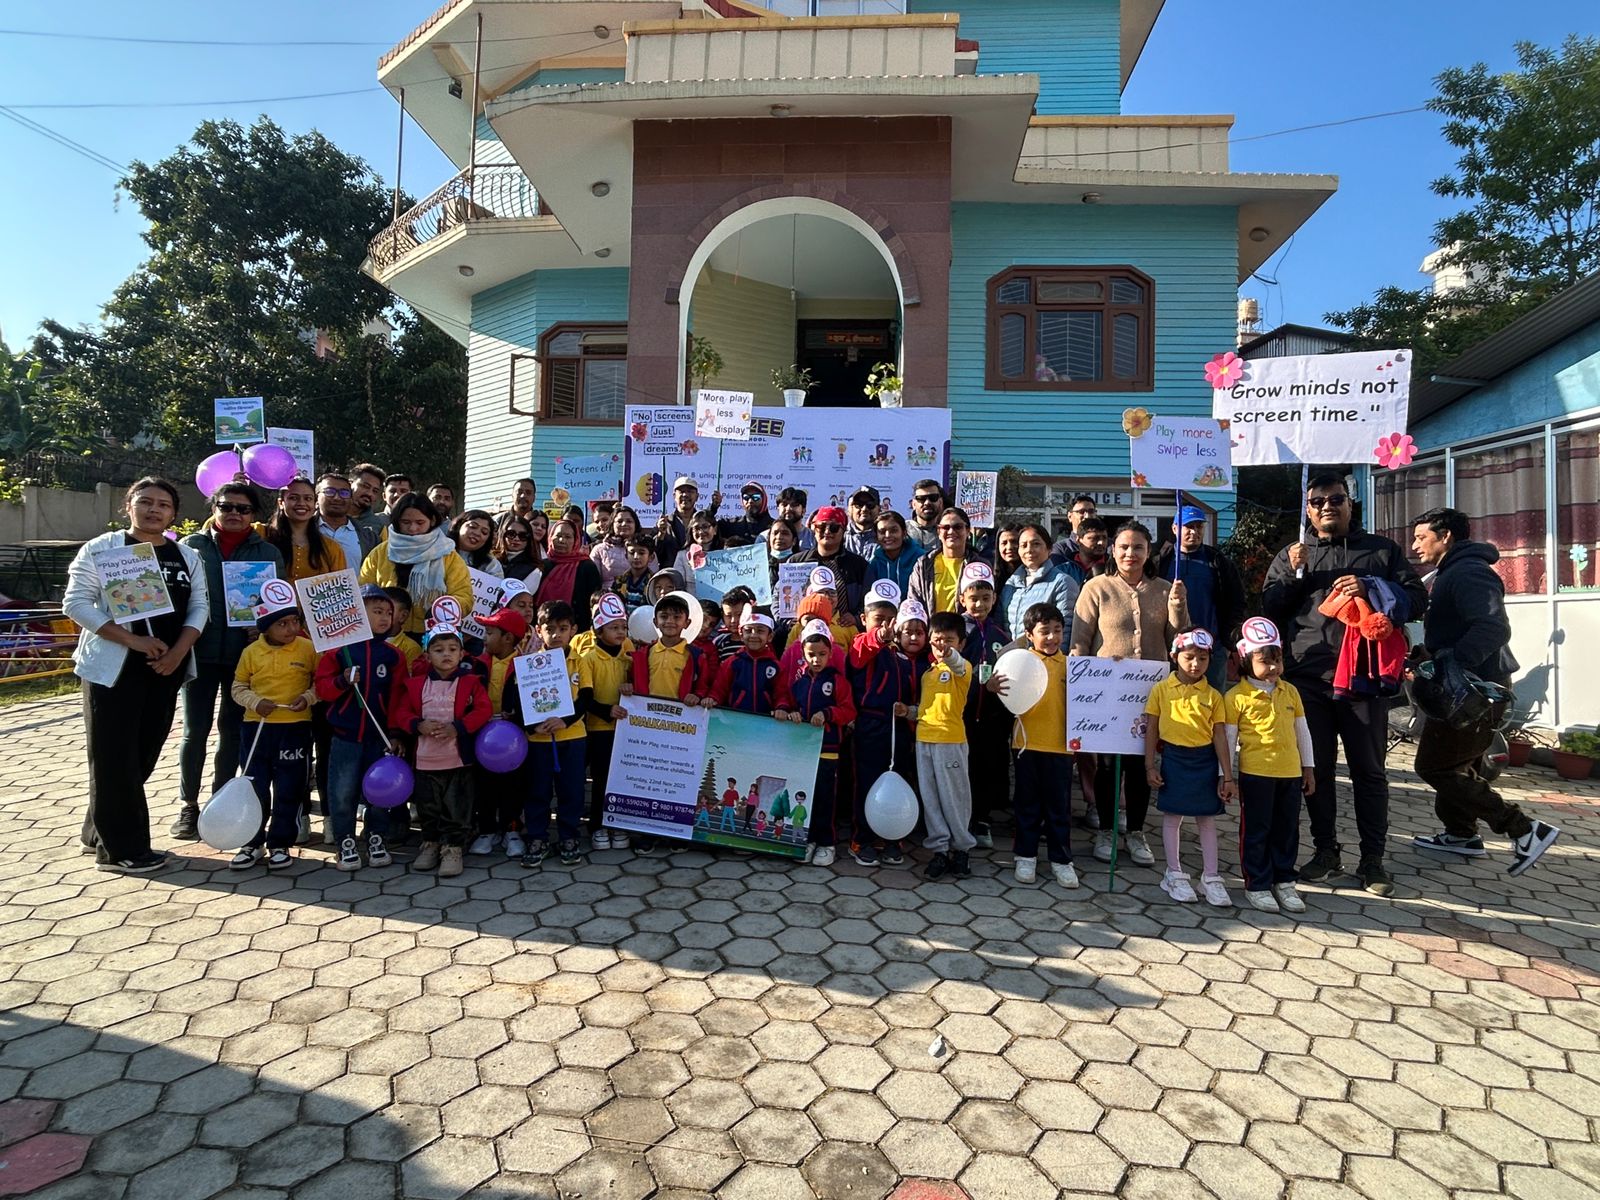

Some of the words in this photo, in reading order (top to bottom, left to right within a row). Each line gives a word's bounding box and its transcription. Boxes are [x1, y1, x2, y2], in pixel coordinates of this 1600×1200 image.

[1289, 378, 1350, 396] minds
[1361, 377, 1399, 395] not
[716, 408, 733, 418] less
[1232, 408, 1301, 424] screen
[653, 427, 672, 436] Just
[1156, 425, 1175, 442] Play
[1196, 443, 1217, 457] less
[563, 463, 599, 475] Screens
[727, 473, 773, 482] programmes
[737, 550, 753, 562] and
[105, 570, 121, 579] Not
[711, 570, 727, 585] play
[306, 577, 350, 597] UNPLUG
[323, 588, 337, 597] THE
[311, 589, 353, 611] SCREENS
[314, 599, 356, 623] UNLEASH
[317, 613, 361, 638] POTENTIAL
[1119, 668, 1164, 683] minds
[1072, 691, 1103, 703] not
[1118, 694, 1148, 704] scre
[647, 702, 683, 717] KIDZEE
[629, 714, 697, 735] WALKATHON
[280, 748, 304, 760] K&K
[670, 744, 689, 752] screens
[648, 756, 669, 764] together
[670, 760, 690, 768] towards
